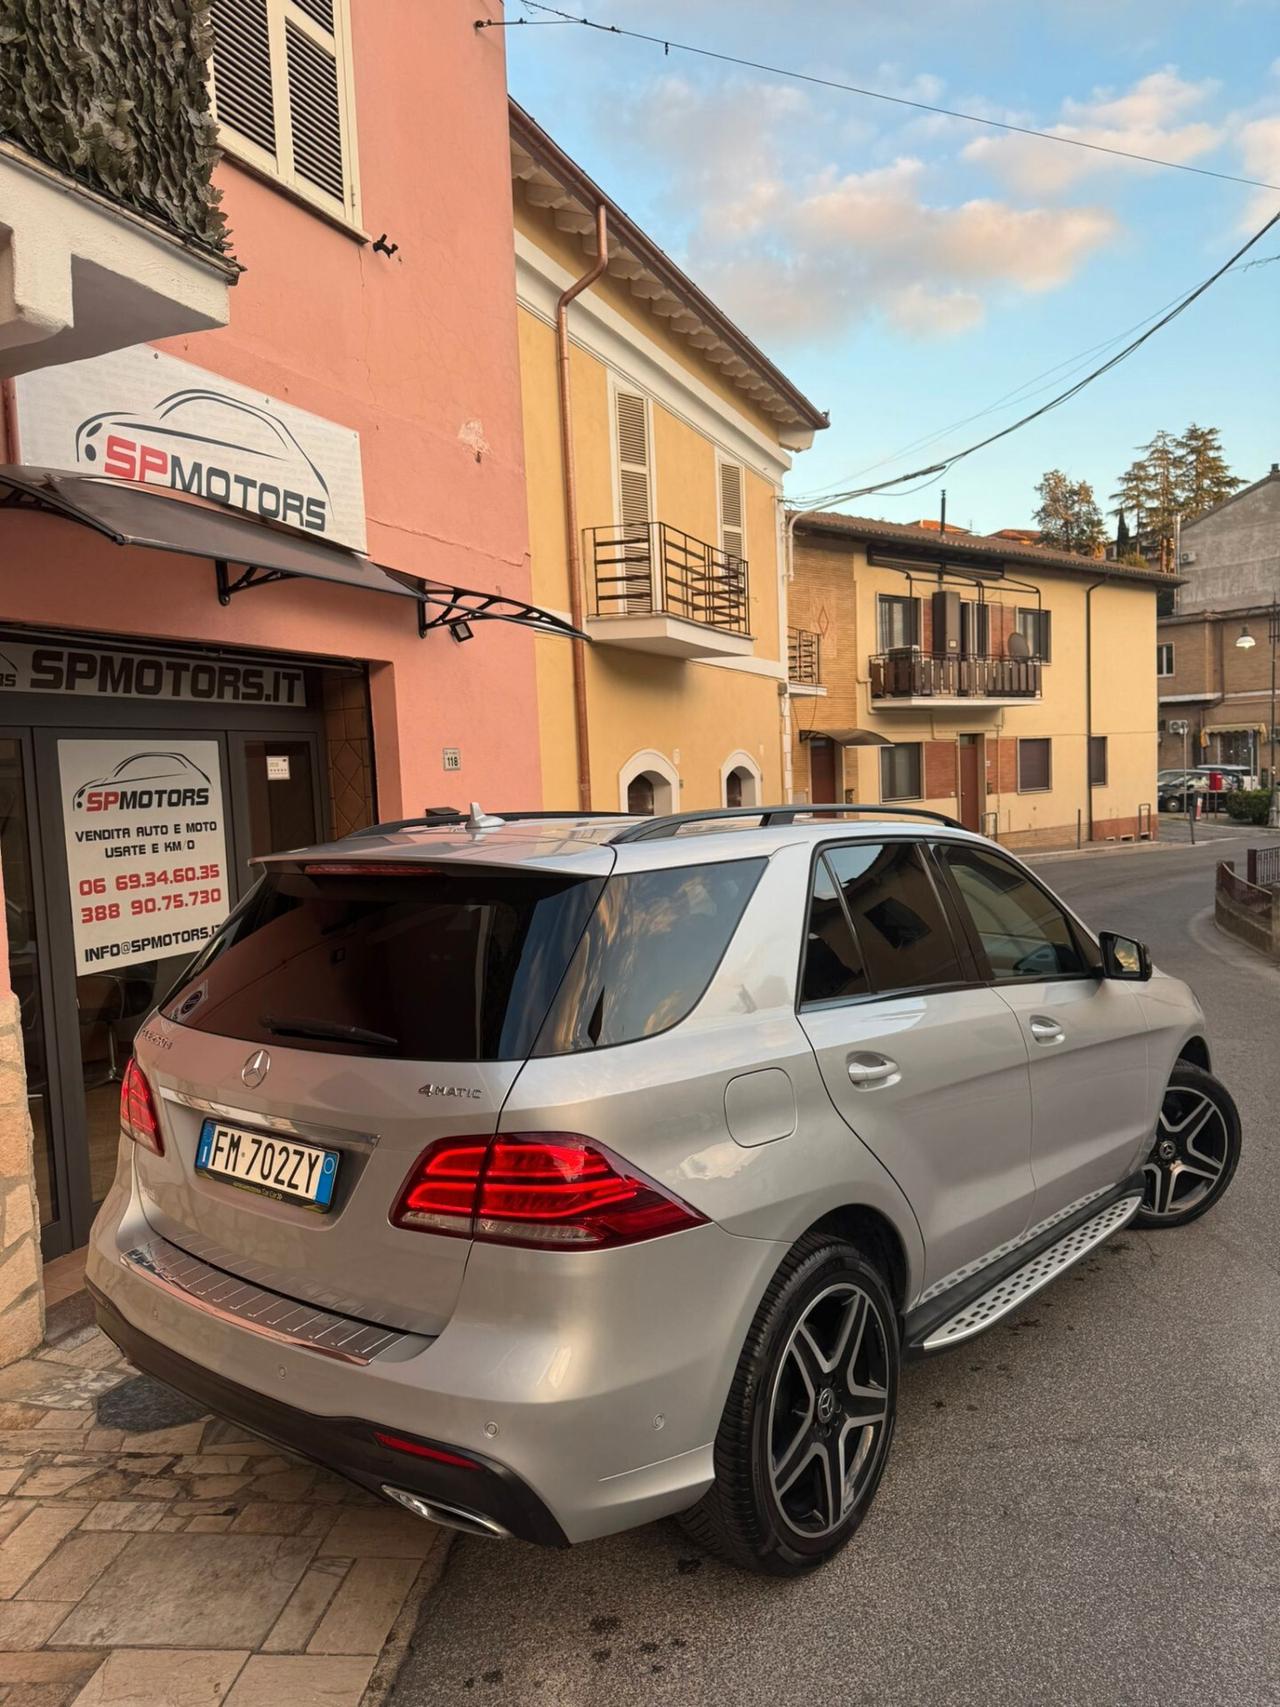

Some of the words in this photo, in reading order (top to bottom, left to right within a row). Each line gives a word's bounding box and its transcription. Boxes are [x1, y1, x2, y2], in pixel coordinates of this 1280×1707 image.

[104, 435, 326, 532] SPMOTORS
[30, 650, 302, 704] SPMOTORS.IT
[447, 756, 458, 766] 118
[86, 788, 209, 812] SPMOTORS
[75, 828, 131, 843] VENDITA
[136, 825, 169, 837] AUTO
[173, 824, 181, 834] E
[186, 821, 217, 833] MOTO
[105, 844, 146, 858] USATE
[152, 843, 159, 854] E
[79, 878, 106, 896] 06
[115, 864, 220, 891] 69.34.60.35
[81, 903, 120, 924] 388
[131, 888, 221, 916] 90.75.730
